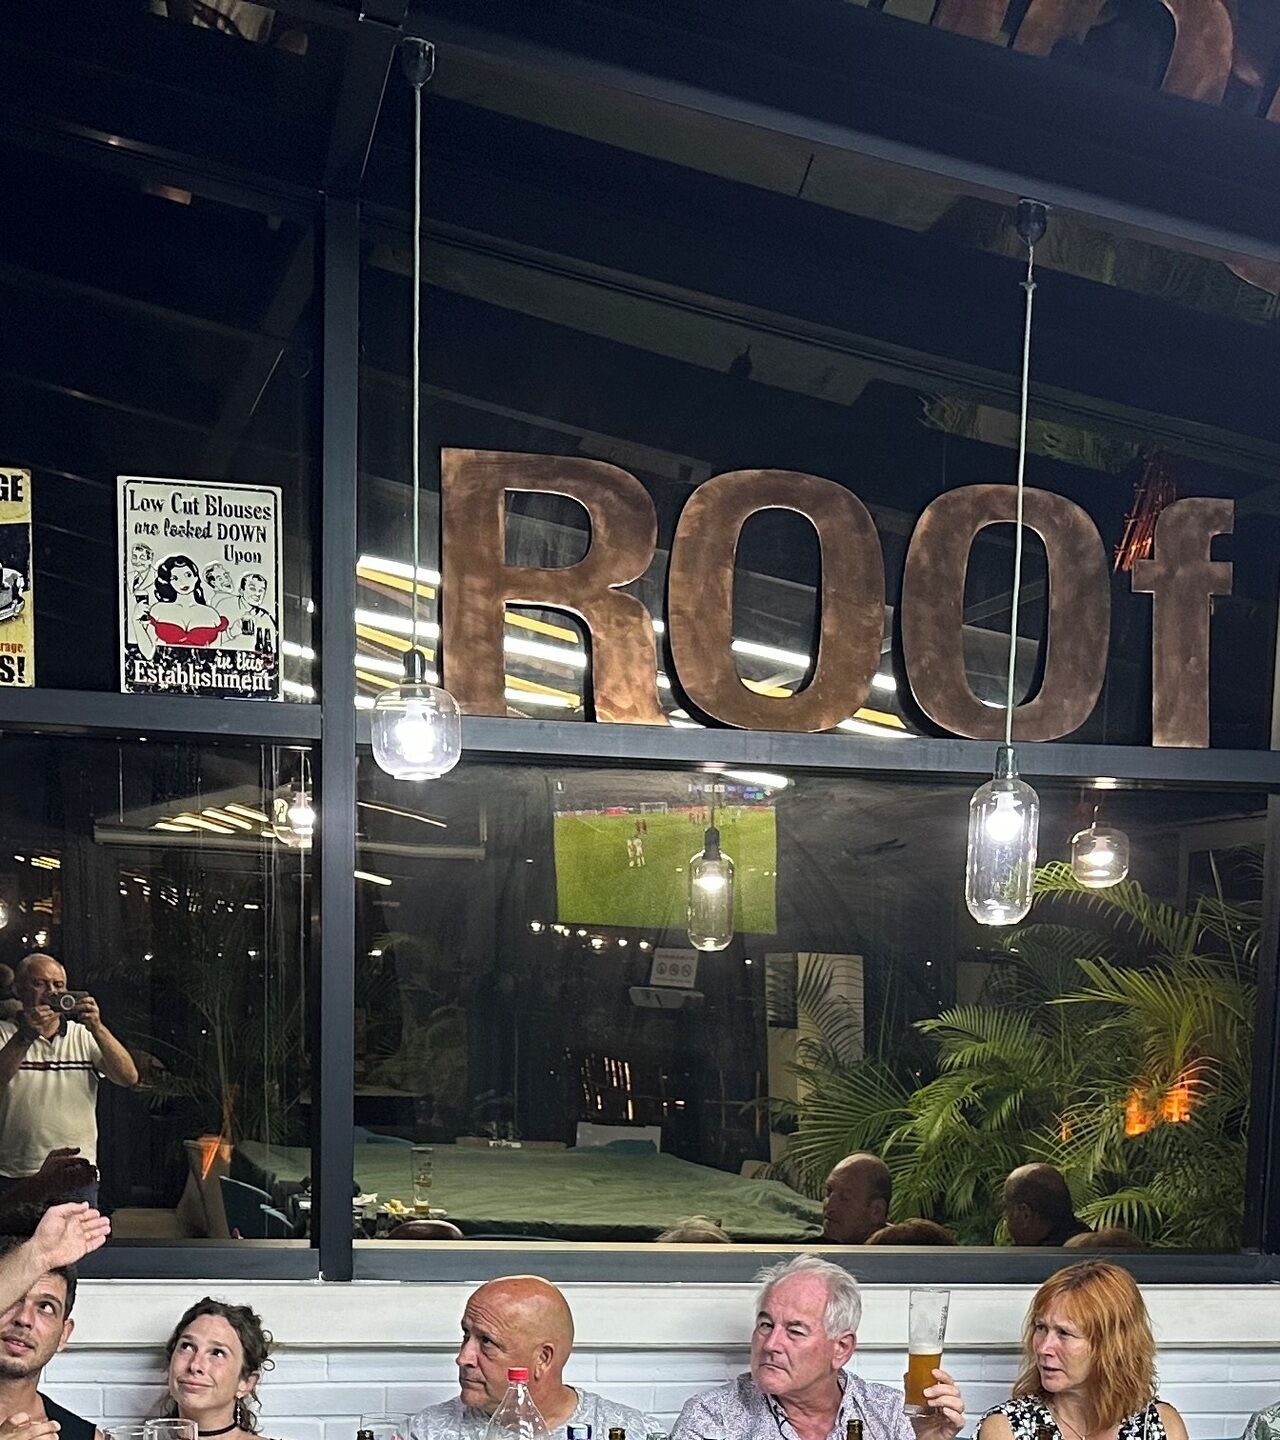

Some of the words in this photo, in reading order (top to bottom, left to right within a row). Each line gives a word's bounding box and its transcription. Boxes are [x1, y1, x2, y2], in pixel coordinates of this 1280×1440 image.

[129, 489, 164, 513] Low
[171, 492, 199, 516] Cut
[205, 494, 272, 520] Blouses
[134, 521, 160, 536] are
[217, 523, 267, 544] DOWN
[223, 544, 262, 564] Upon
[215, 651, 234, 669] in
[235, 652, 265, 672] this
[133, 659, 273, 692] Establishment
